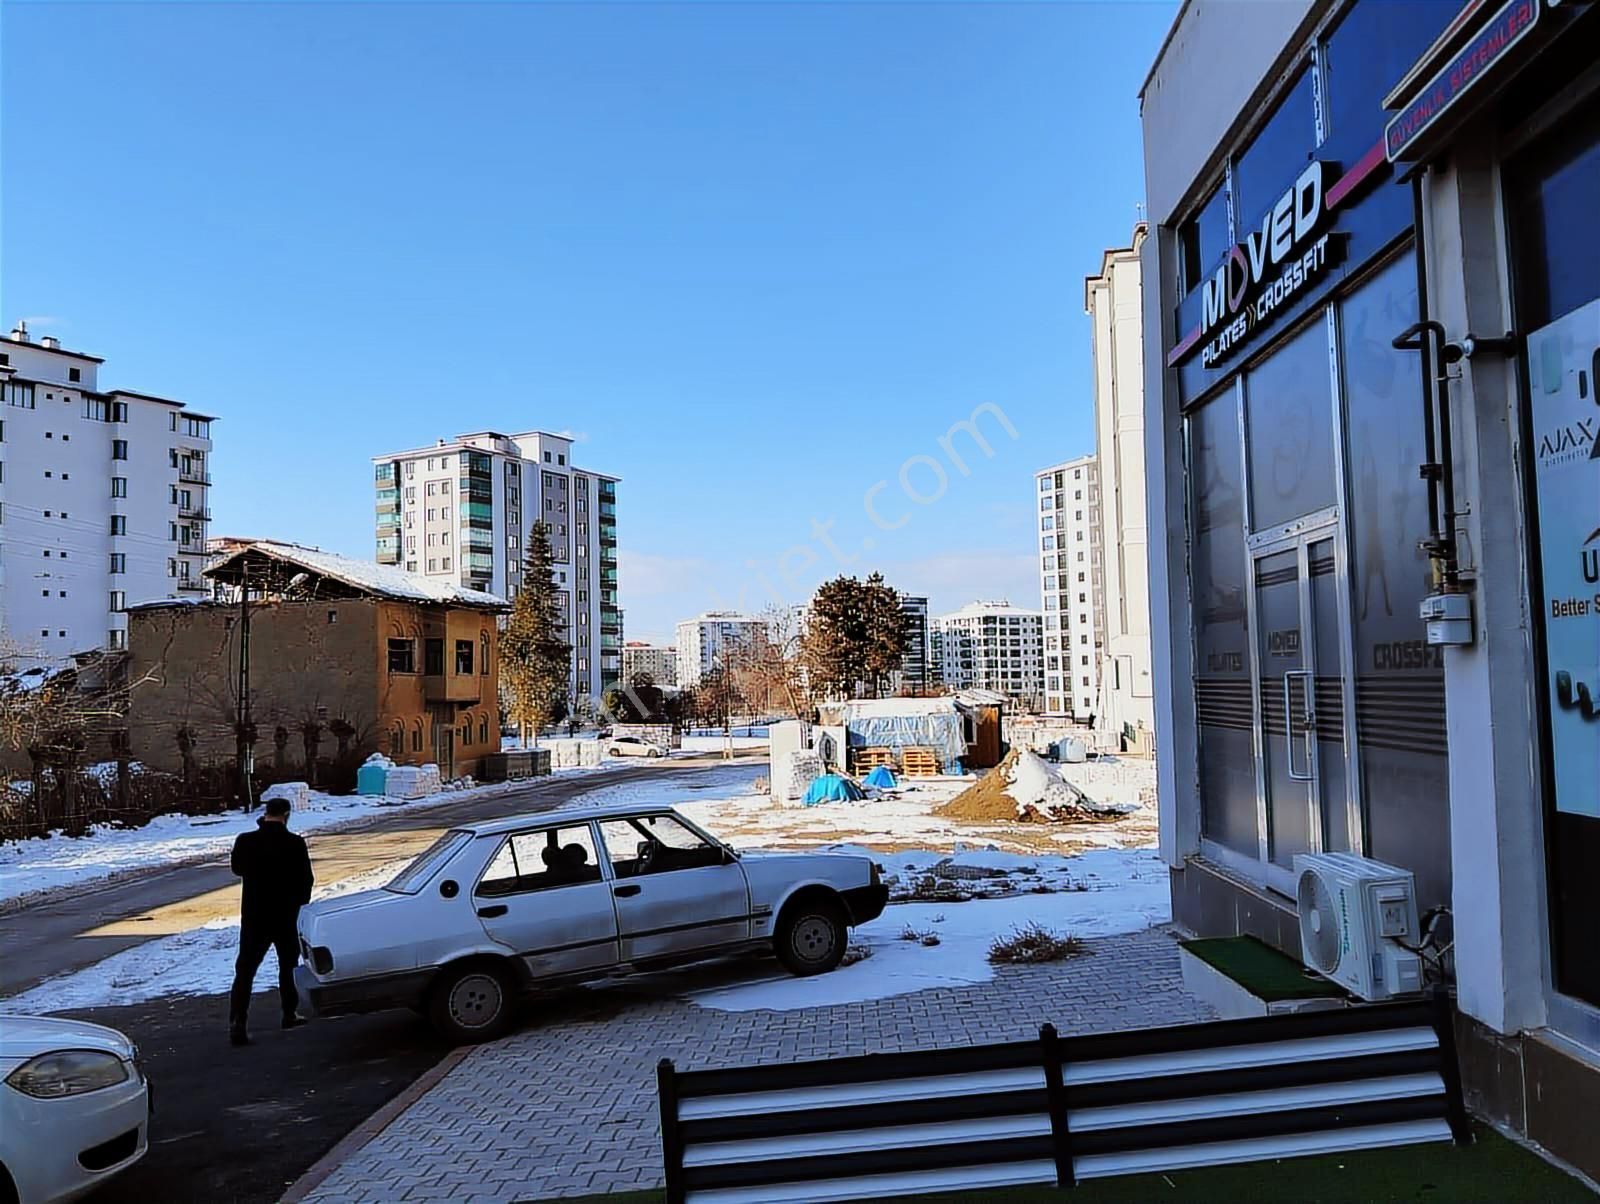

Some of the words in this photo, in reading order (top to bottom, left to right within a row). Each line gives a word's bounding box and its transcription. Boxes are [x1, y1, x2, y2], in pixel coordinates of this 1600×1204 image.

[1202, 161, 1321, 334] MOVED
[1257, 233, 1328, 321] CROSSFIT
[1540, 417, 1594, 459] AJAX
[1552, 596, 1590, 618] Better
